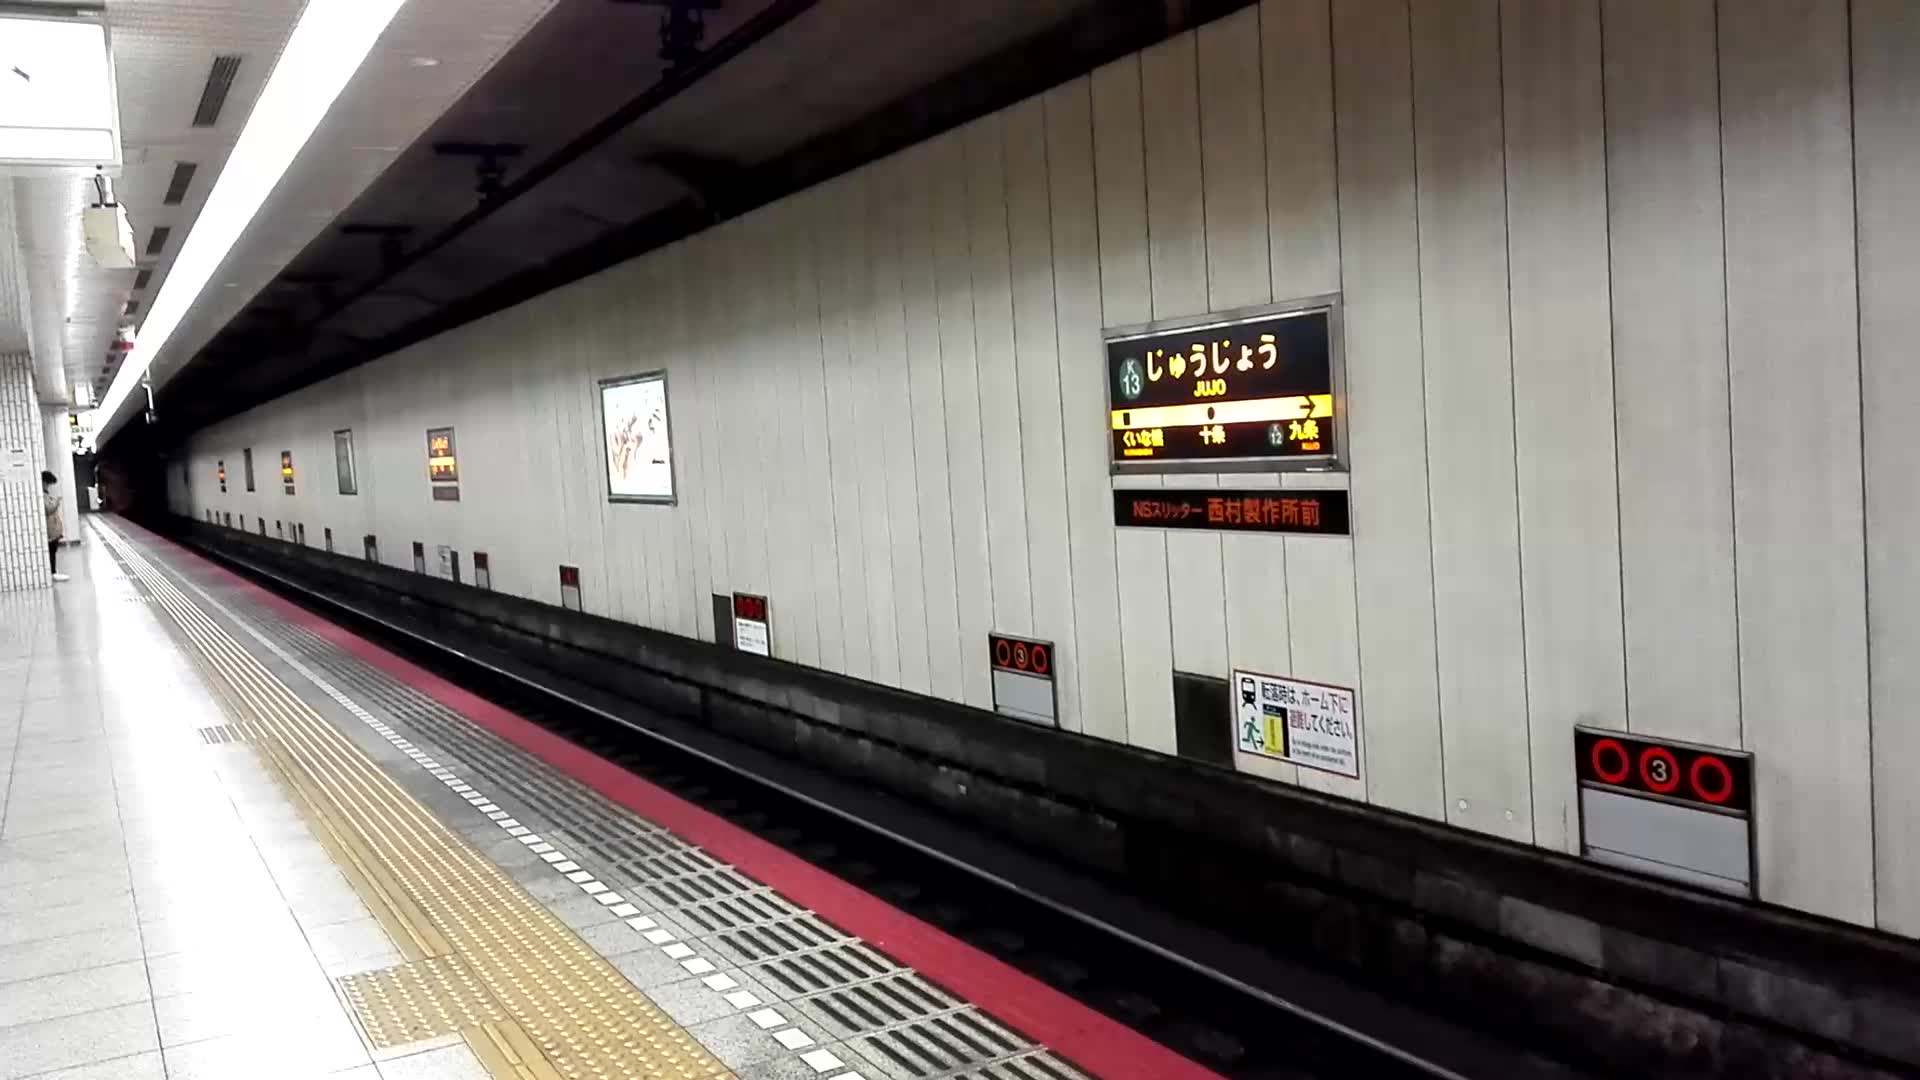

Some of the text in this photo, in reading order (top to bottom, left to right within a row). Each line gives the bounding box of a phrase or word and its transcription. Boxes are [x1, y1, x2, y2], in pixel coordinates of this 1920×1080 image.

[1126, 361, 1135, 372] K
[1146, 334, 1278, 382] じゅうじょう
[1122, 375, 1141, 395] 13
[1193, 378, 1227, 397] JUJO
[1199, 425, 1226, 445] 十条
[1270, 432, 1283, 445] 12
[1289, 420, 1319, 441] 九条
[1208, 498, 1320, 526] 西村製作所前
[1651, 759, 1668, 782] 3
